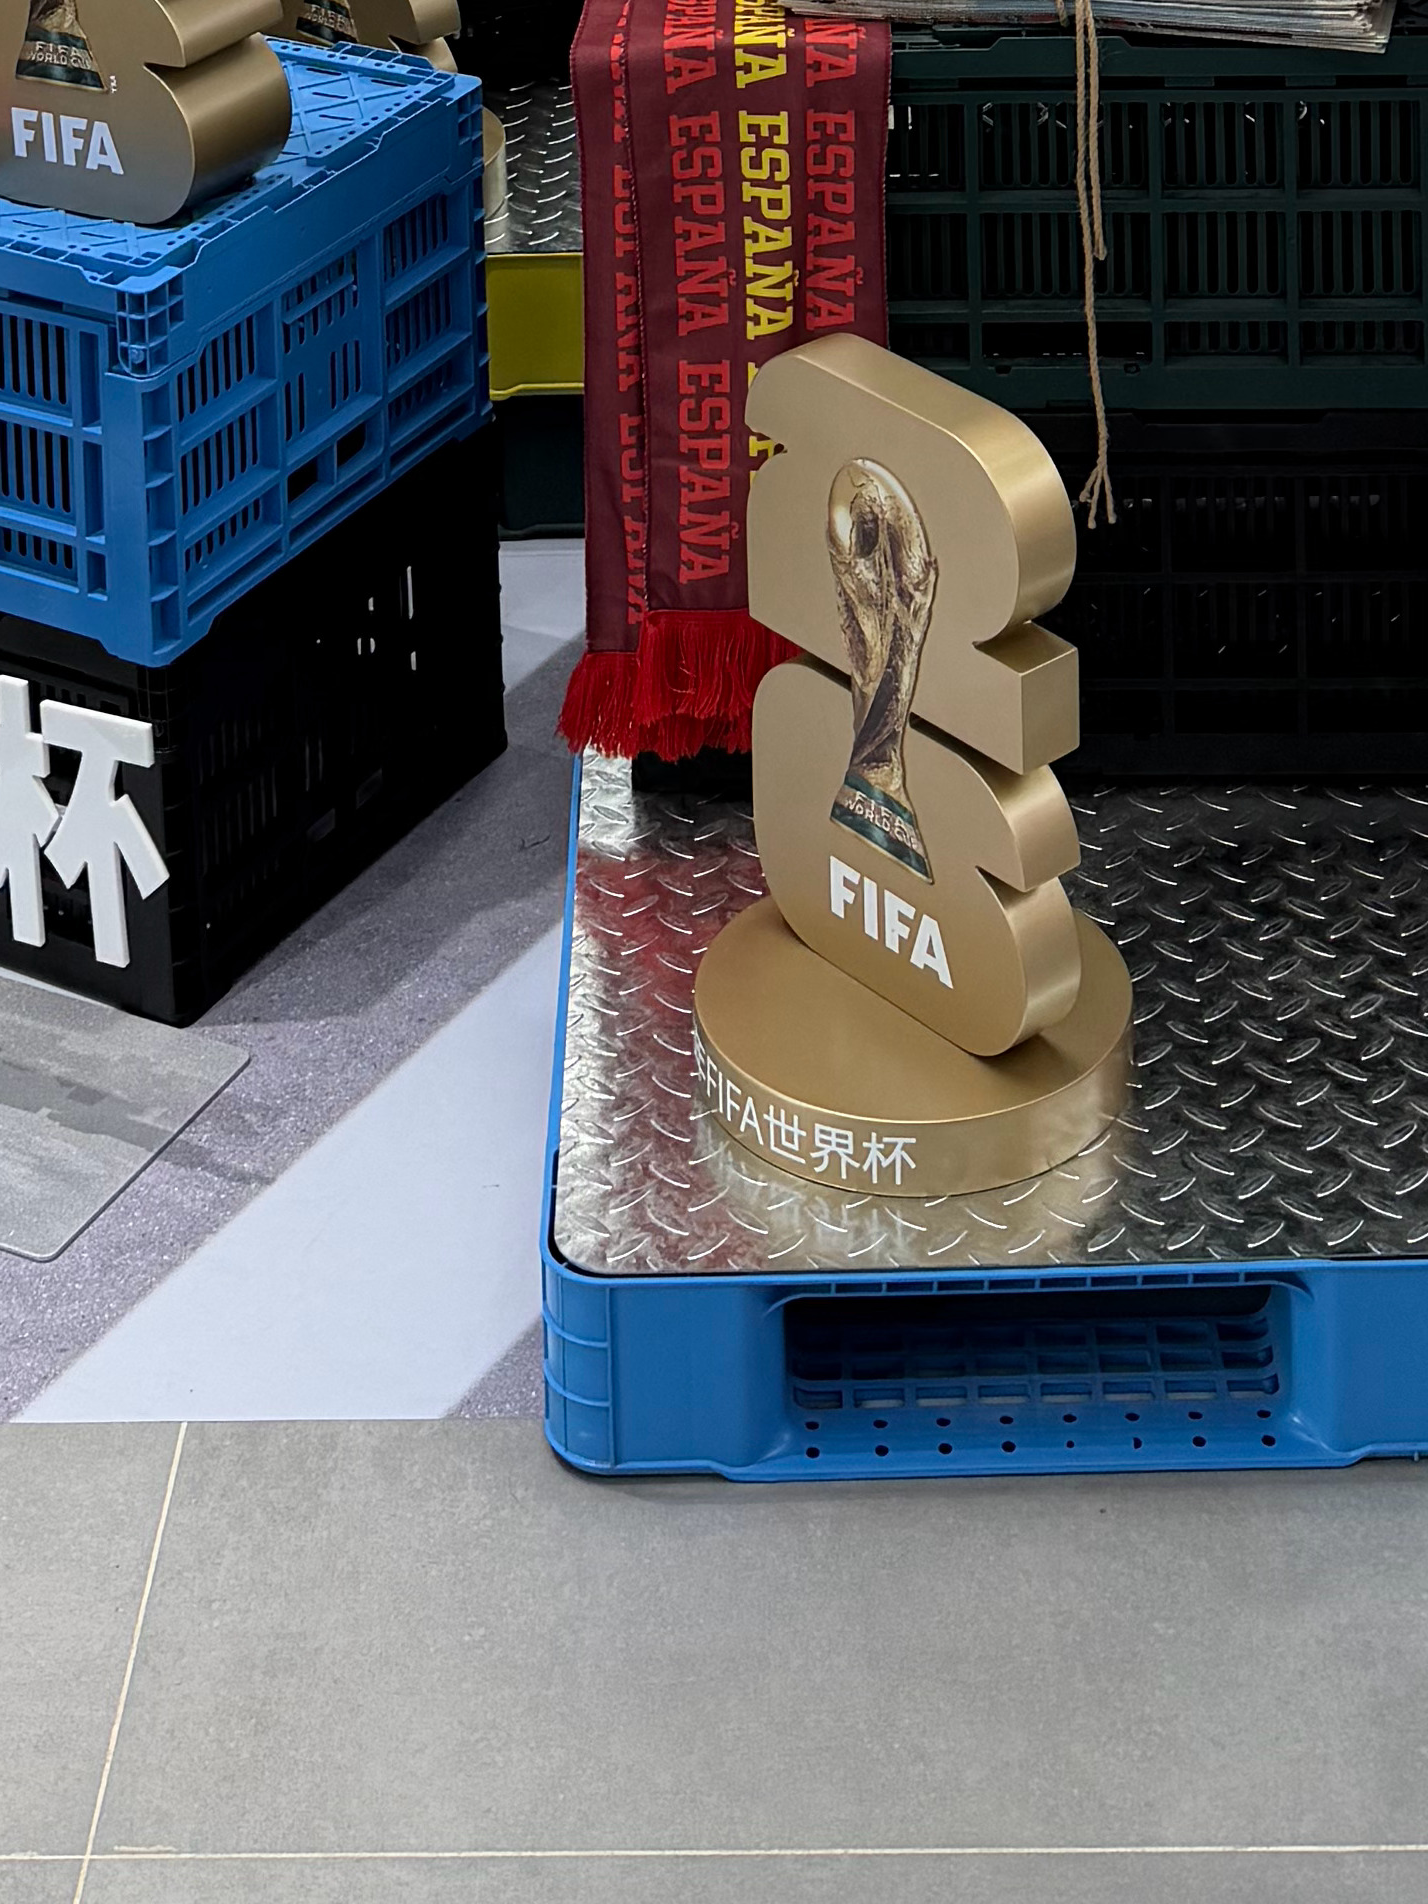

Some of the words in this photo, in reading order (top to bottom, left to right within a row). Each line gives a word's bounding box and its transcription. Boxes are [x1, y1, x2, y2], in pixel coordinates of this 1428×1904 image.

[11, 106, 125, 175] FIFA
[669, 110, 737, 337] ESPAÑA
[738, 110, 800, 341] ESPAÑA
[805, 108, 864, 332] ESPAÑA
[677, 359, 740, 584] ESPAÑA
[855, 792, 908, 826] FIFA
[829, 855, 954, 990] FIFA
